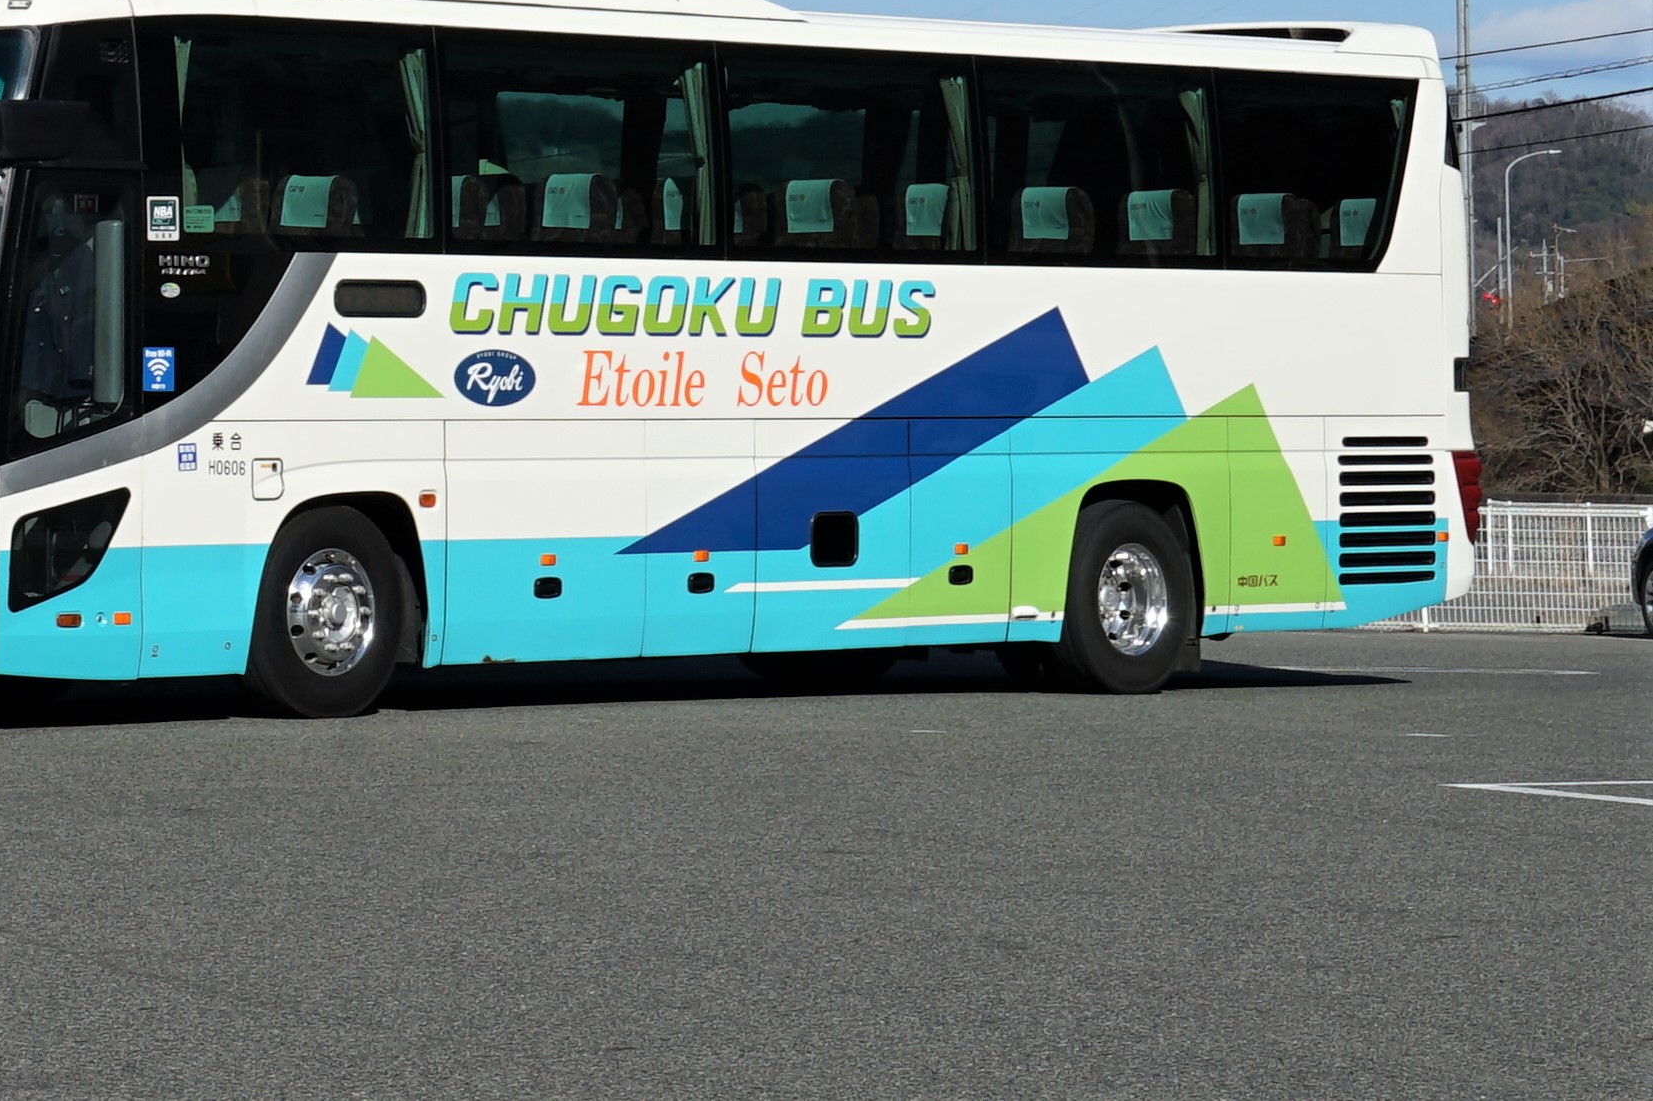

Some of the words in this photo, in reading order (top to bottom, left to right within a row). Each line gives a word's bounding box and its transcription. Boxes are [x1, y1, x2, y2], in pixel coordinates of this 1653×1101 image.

[153, 205, 173, 218] NBA
[158, 255, 210, 267] HINO
[449, 272, 781, 336] CHUGOKU
[800, 278, 936, 338] BUS
[466, 362, 524, 404] Ryobi
[575, 349, 705, 407] Etoile
[737, 350, 829, 408] Seto
[212, 432, 242, 451] 乗合
[208, 460, 246, 476] H0606
[1238, 574, 1278, 587] 中国バス
